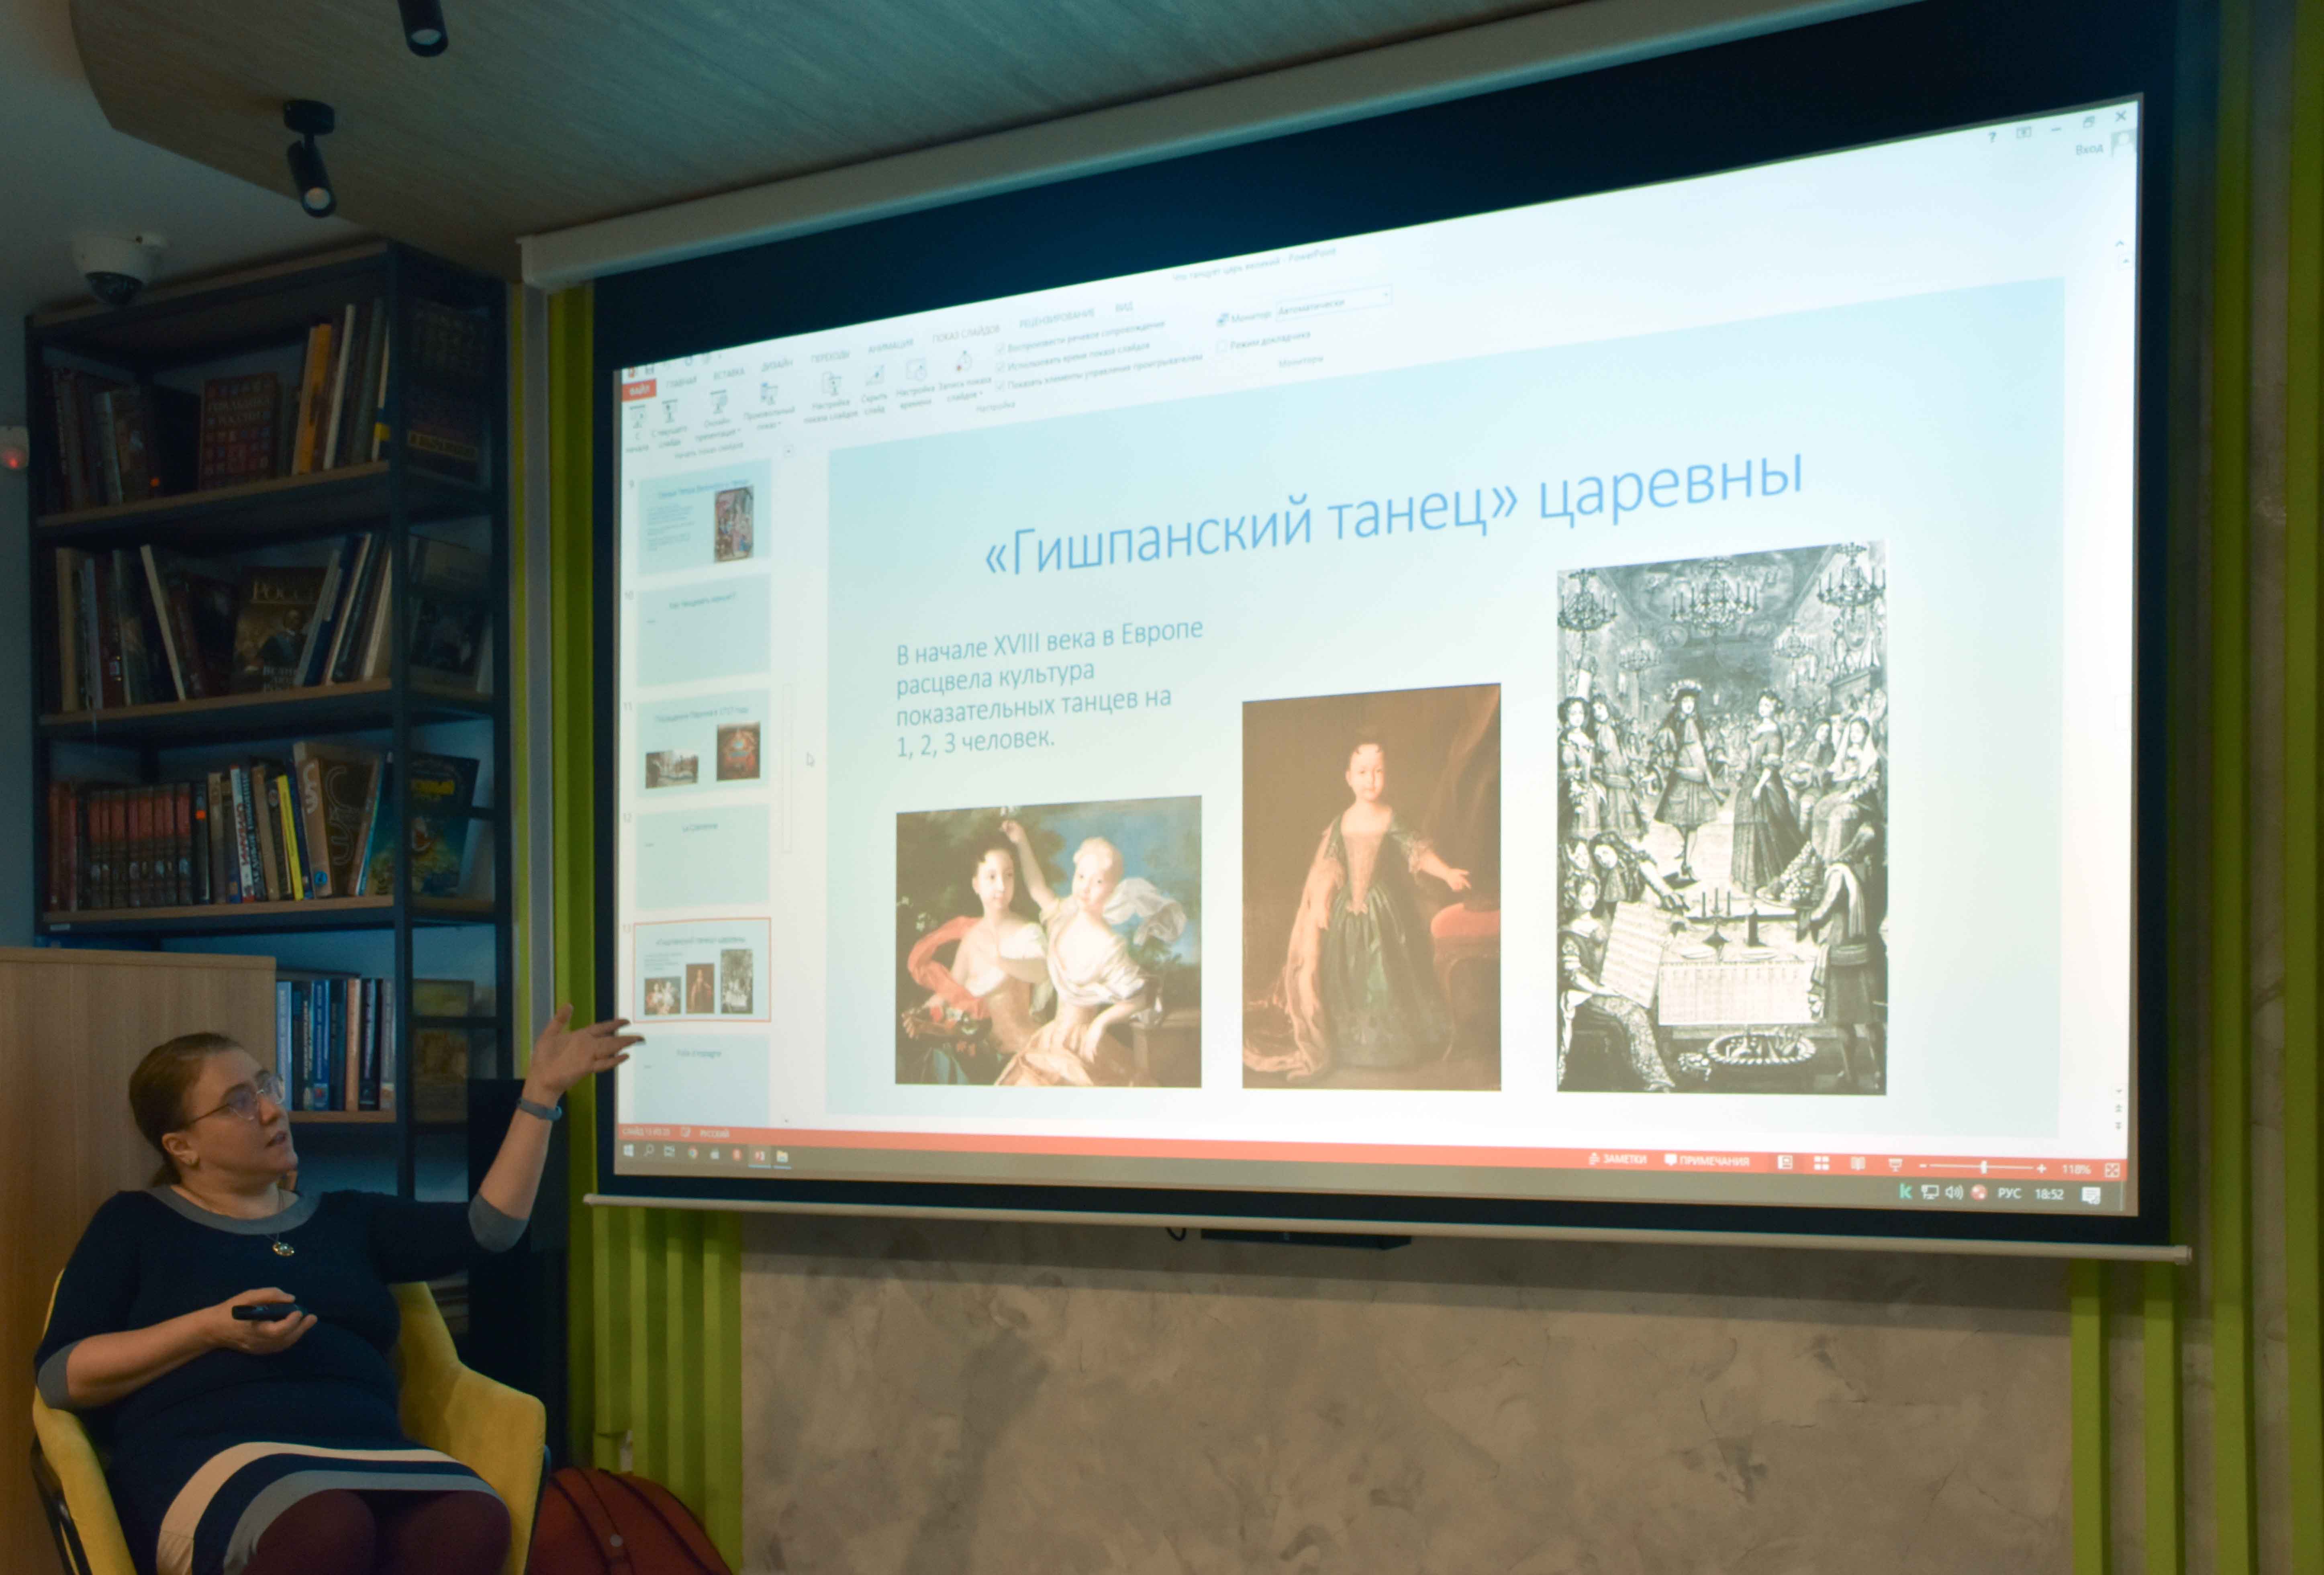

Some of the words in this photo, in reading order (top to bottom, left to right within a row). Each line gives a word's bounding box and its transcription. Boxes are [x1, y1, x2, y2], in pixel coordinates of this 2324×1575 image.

[1288, 247, 1337, 264] PowerPoint
[1277, 298, 1346, 316] Автоматически
[932, 332, 960, 344] ПОКАЗ
[960, 324, 1001, 340] СЛАЙДОВ
[985, 492, 1311, 575] «Гишпанский
[1327, 485, 1518, 540] танец»
[1540, 453, 1801, 529] царевны
[897, 645, 909, 666] В
[915, 641, 988, 665] начале
[994, 632, 1040, 656] XVIII
[1047, 631, 1095, 652] века
[1103, 629, 1114, 647] в
[1121, 620, 1204, 647] Европе
[897, 671, 992, 700] расцвела
[999, 662, 1095, 690] культура
[897, 698, 1055, 727] показательных
[1061, 690, 1137, 715] танцев
[1145, 688, 1172, 708] на
[897, 737, 914, 760] 1,
[920, 734, 938, 758] 2,
[944, 732, 956, 754] 3
[962, 729, 1055, 752] человек.
[1603, 1154, 1647, 1164] ЗАМЕТКИ
[1680, 1154, 1750, 1167] ПРИМЕЧАНИЯ
[2063, 1164, 2091, 1175] 118%
[1997, 1187, 2022, 1200] РУС
[2035, 1189, 2064, 1200] 18:52
